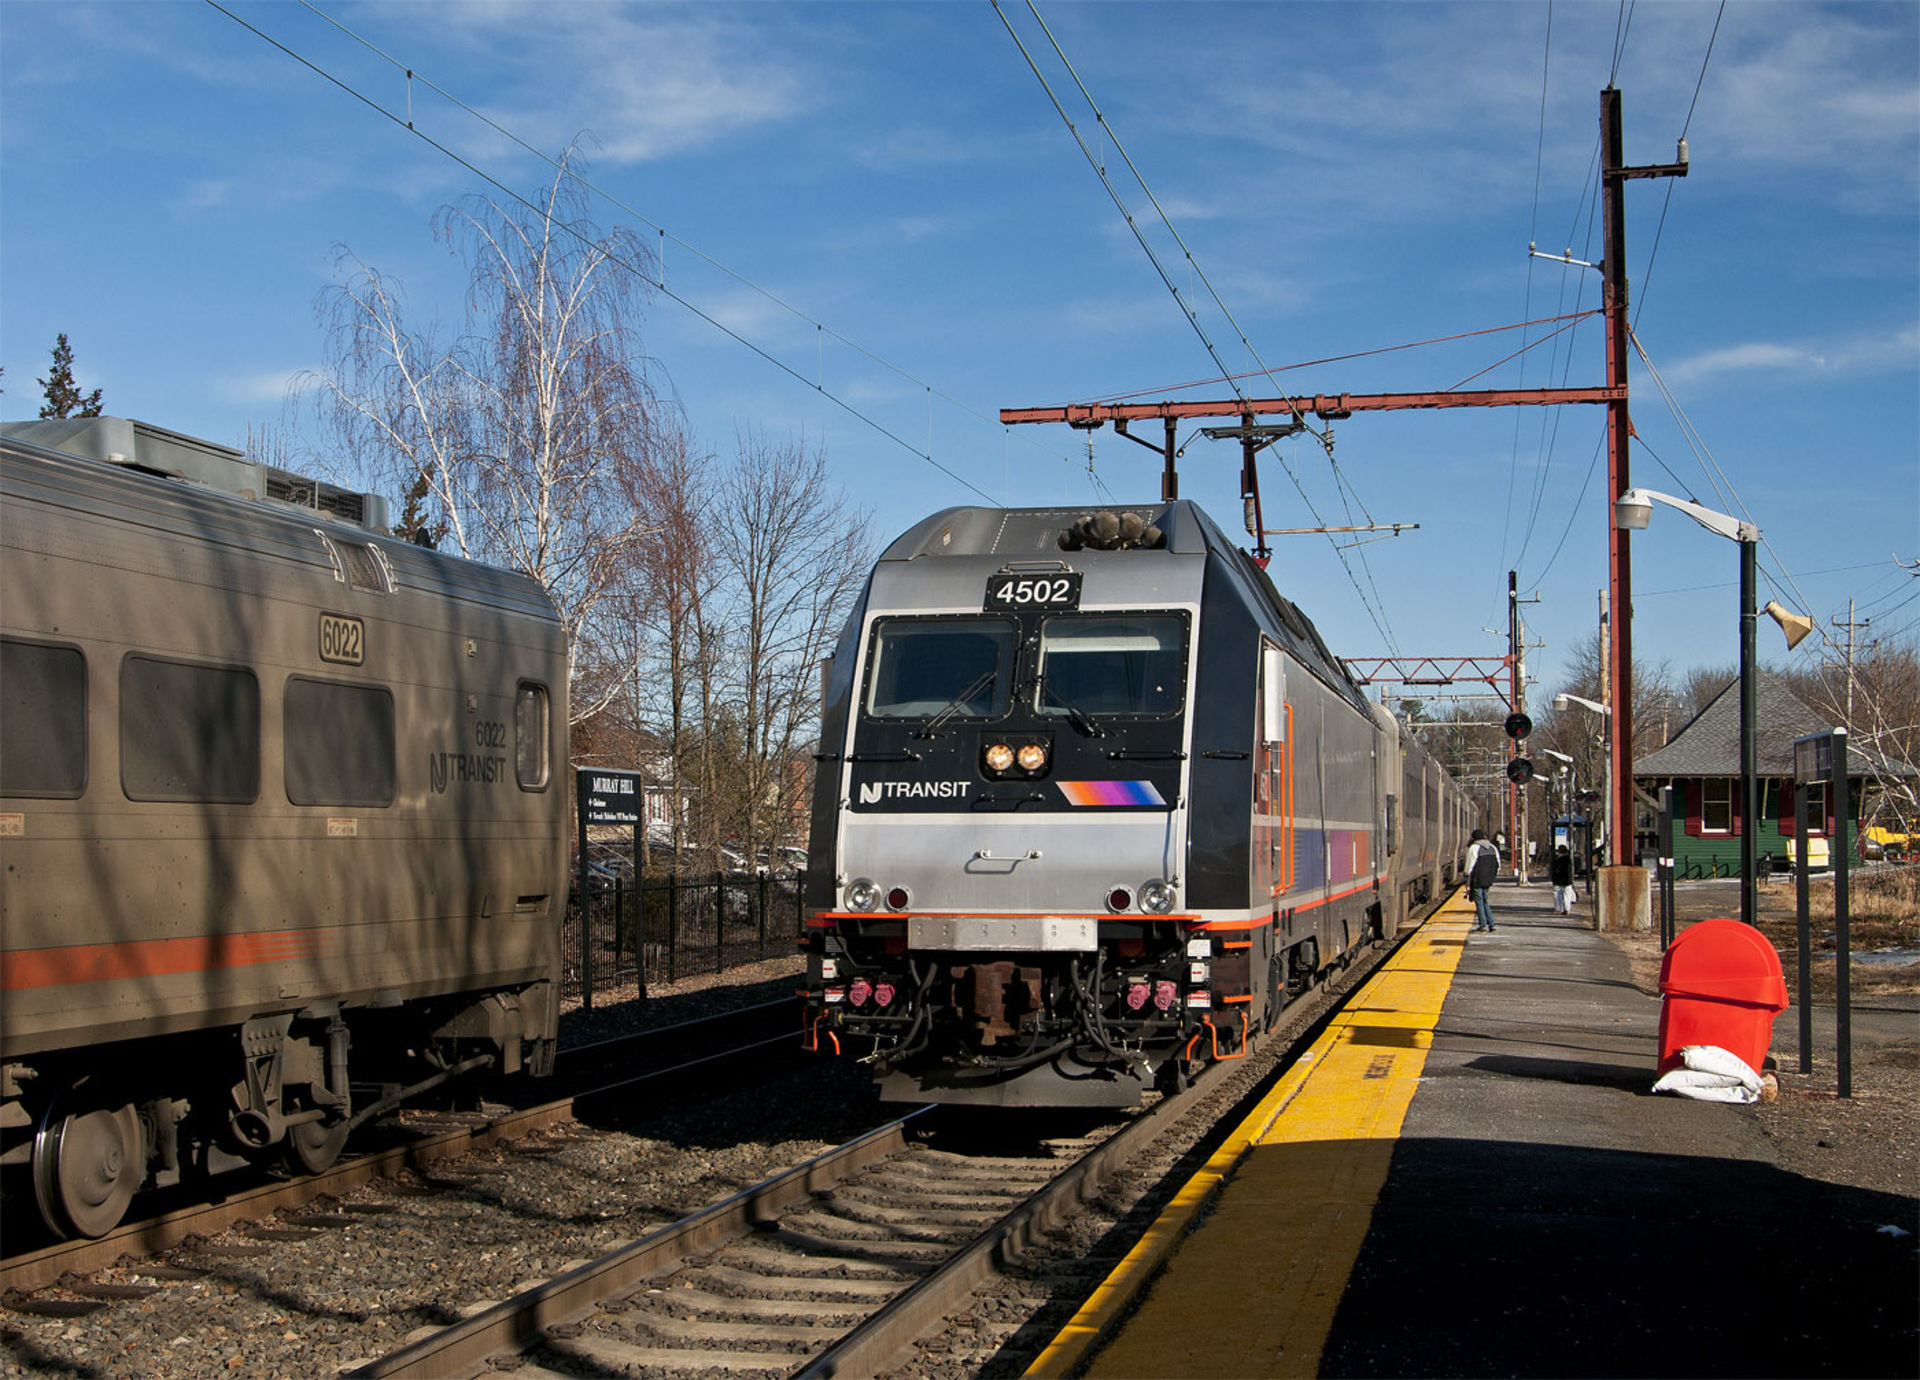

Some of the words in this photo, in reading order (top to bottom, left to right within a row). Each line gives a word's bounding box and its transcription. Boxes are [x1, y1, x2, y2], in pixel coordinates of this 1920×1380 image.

[997, 579, 1070, 604] 4502
[323, 619, 360, 659] 6022
[476, 721, 506, 749] 6022
[449, 754, 506, 784] TRANSIT
[884, 781, 971, 798] TRANSIT
